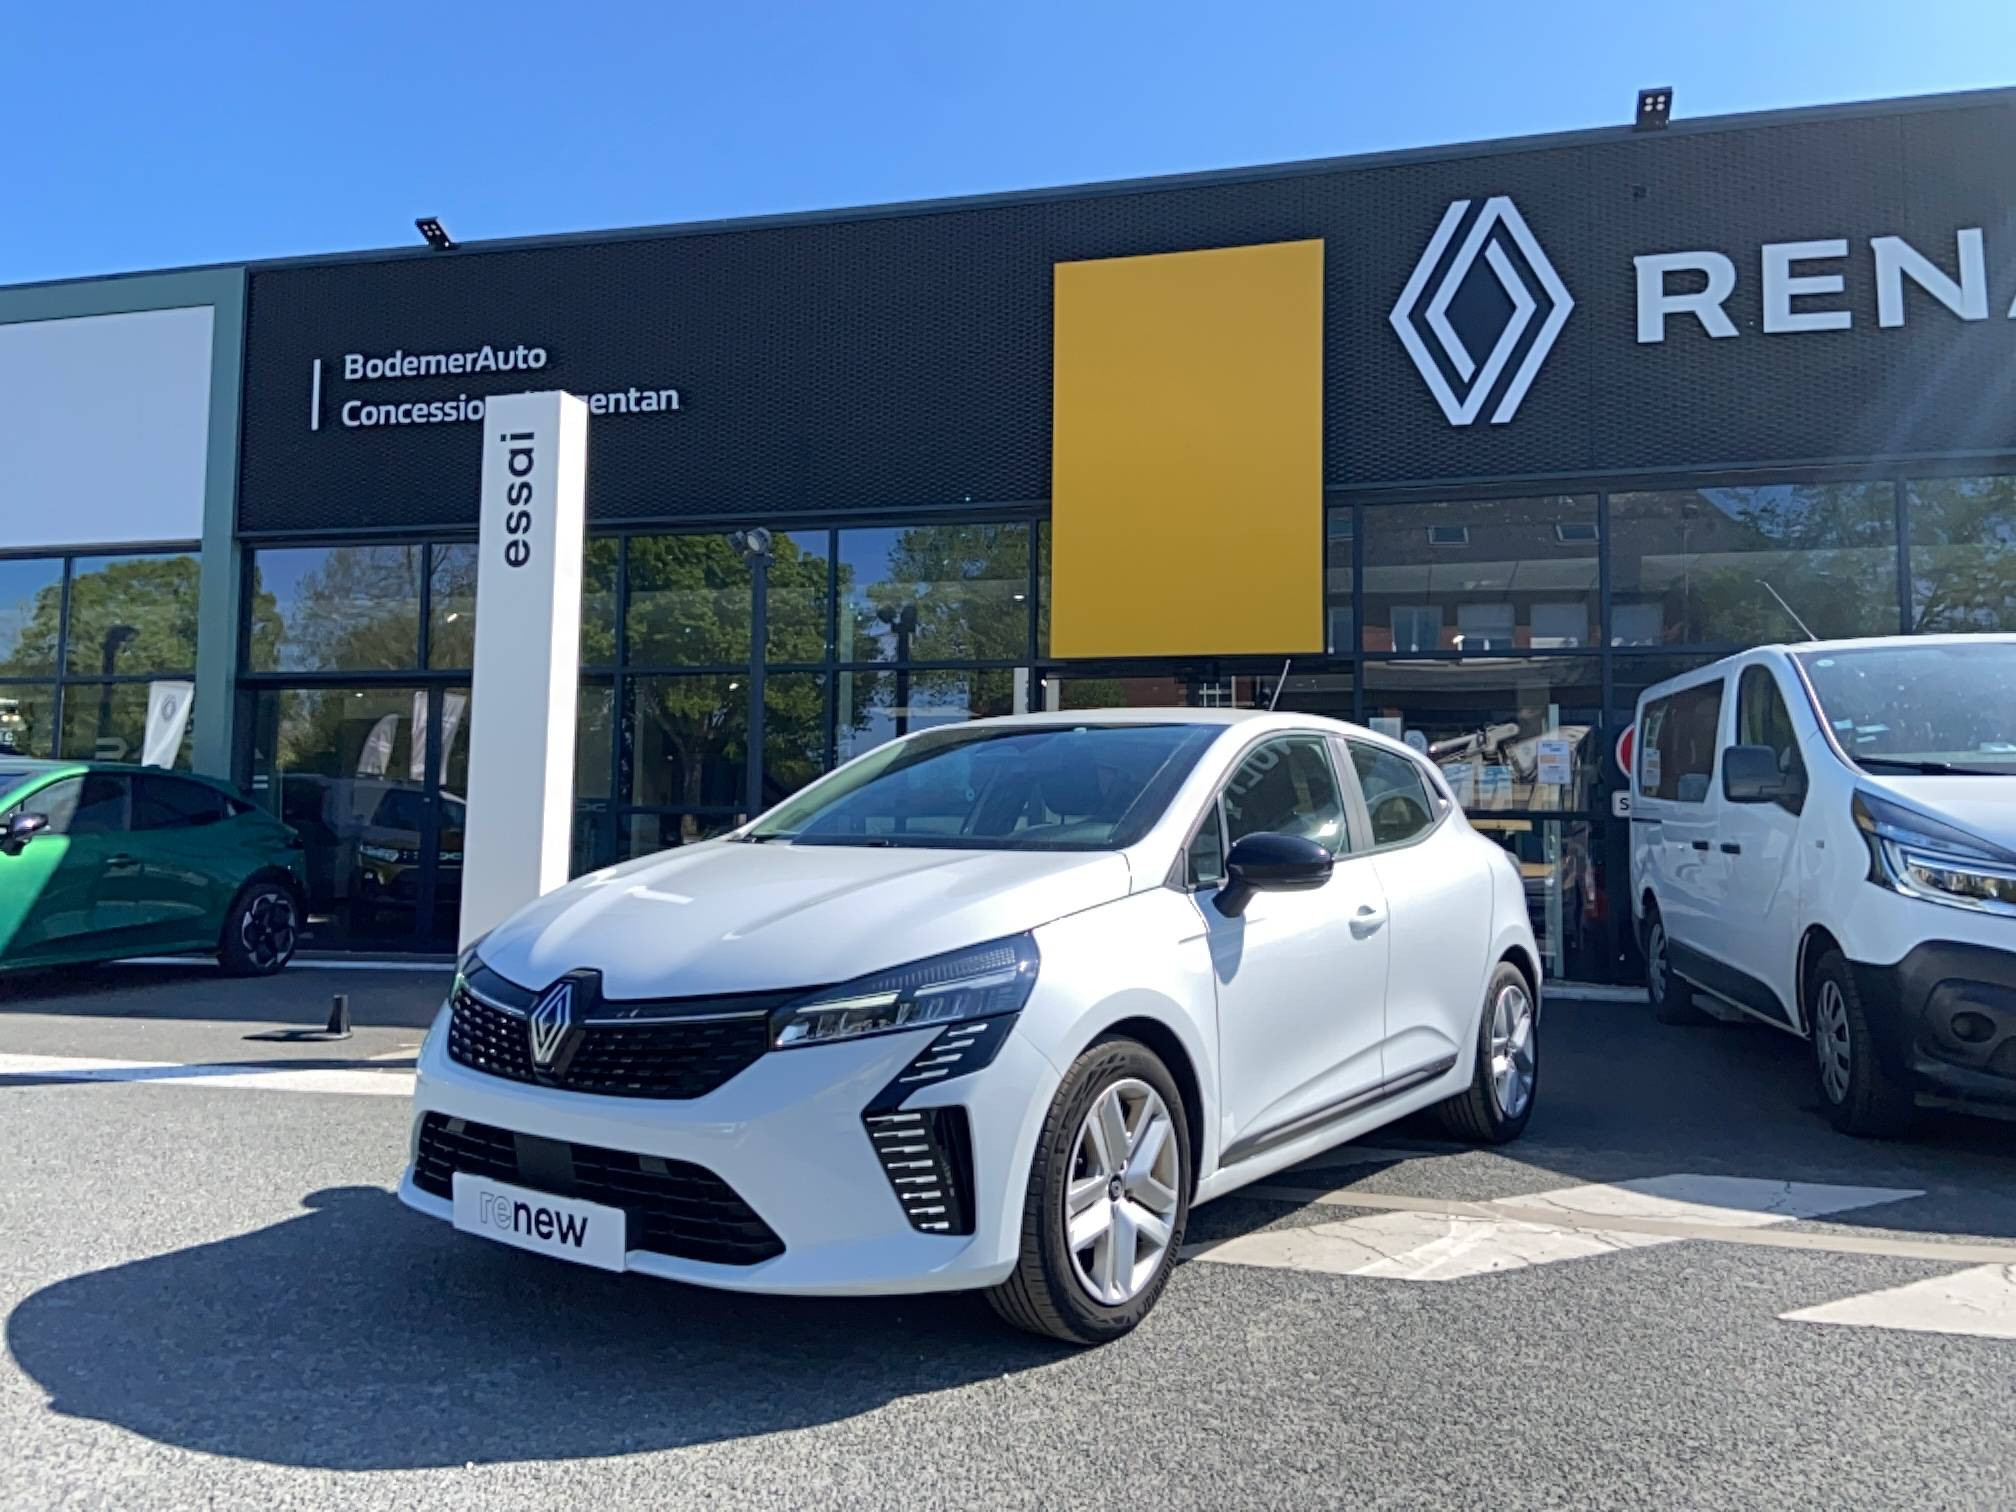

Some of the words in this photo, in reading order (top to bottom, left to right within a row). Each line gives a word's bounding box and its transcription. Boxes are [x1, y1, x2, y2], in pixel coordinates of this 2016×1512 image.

[344, 345, 548, 380] BodemerAuto
[342, 394, 486, 427] Concessio
[576, 387, 680, 415] entan
[500, 431, 535, 568] essai
[480, 1191, 589, 1248] renew
